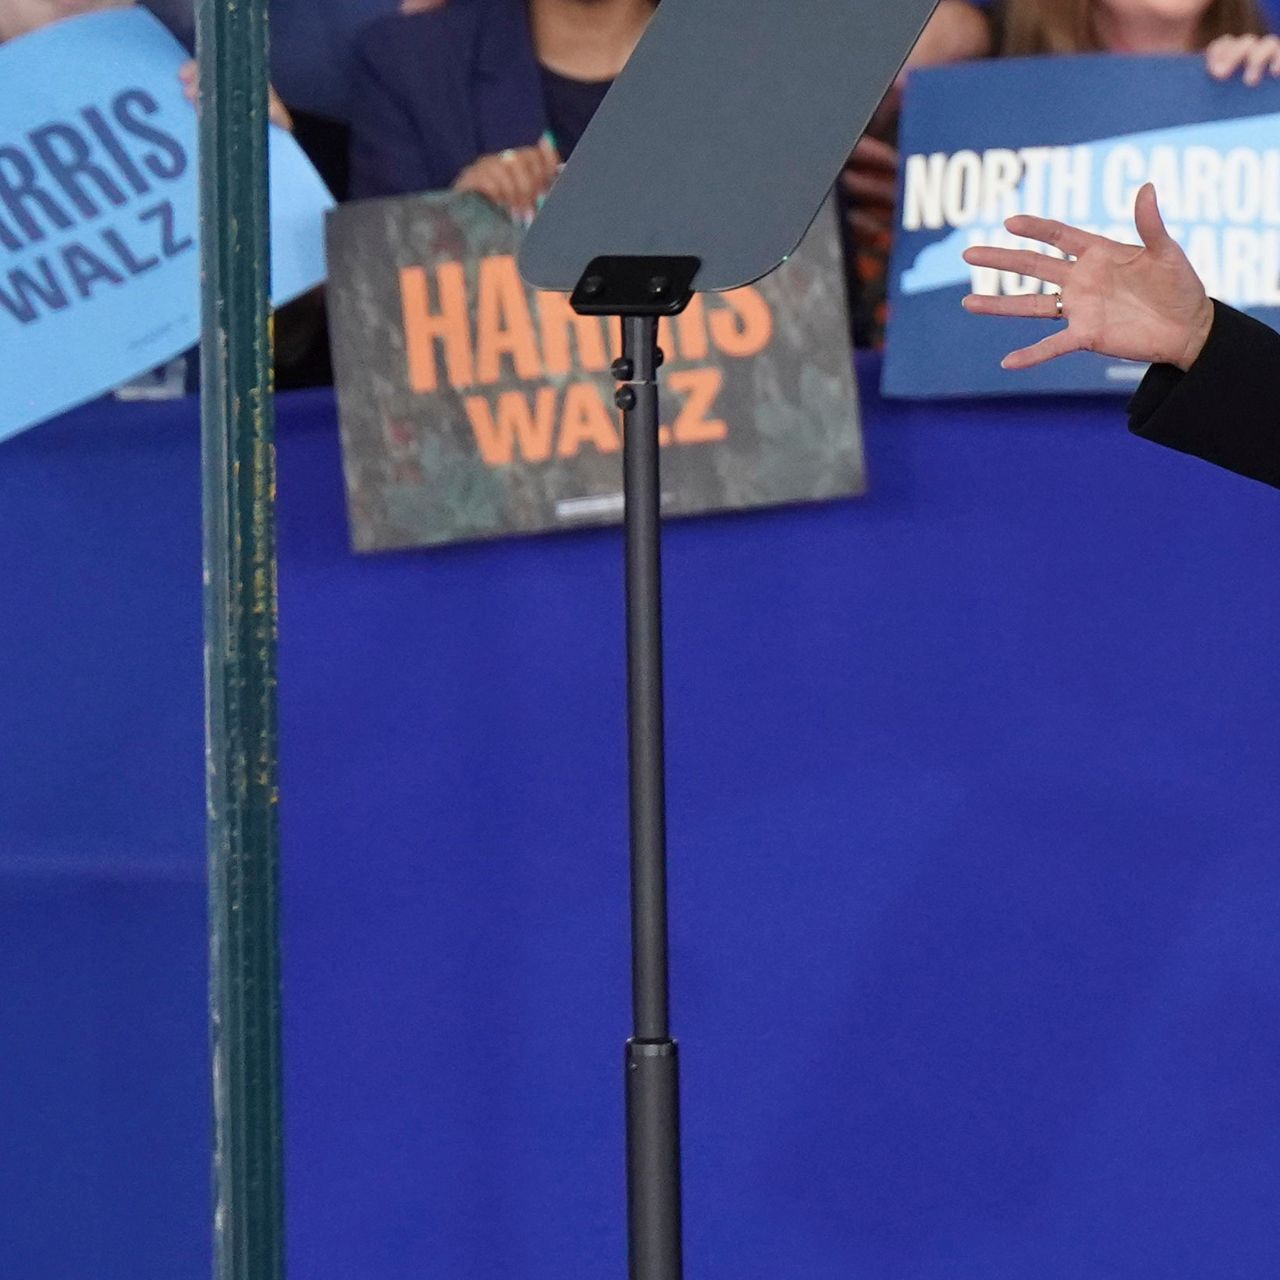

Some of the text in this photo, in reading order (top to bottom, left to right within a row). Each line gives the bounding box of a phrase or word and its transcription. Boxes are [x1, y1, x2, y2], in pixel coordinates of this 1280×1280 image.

[902, 147, 1094, 230] NORTH
[0, 200, 194, 326] WALZ
[465, 364, 729, 467] WAZ
